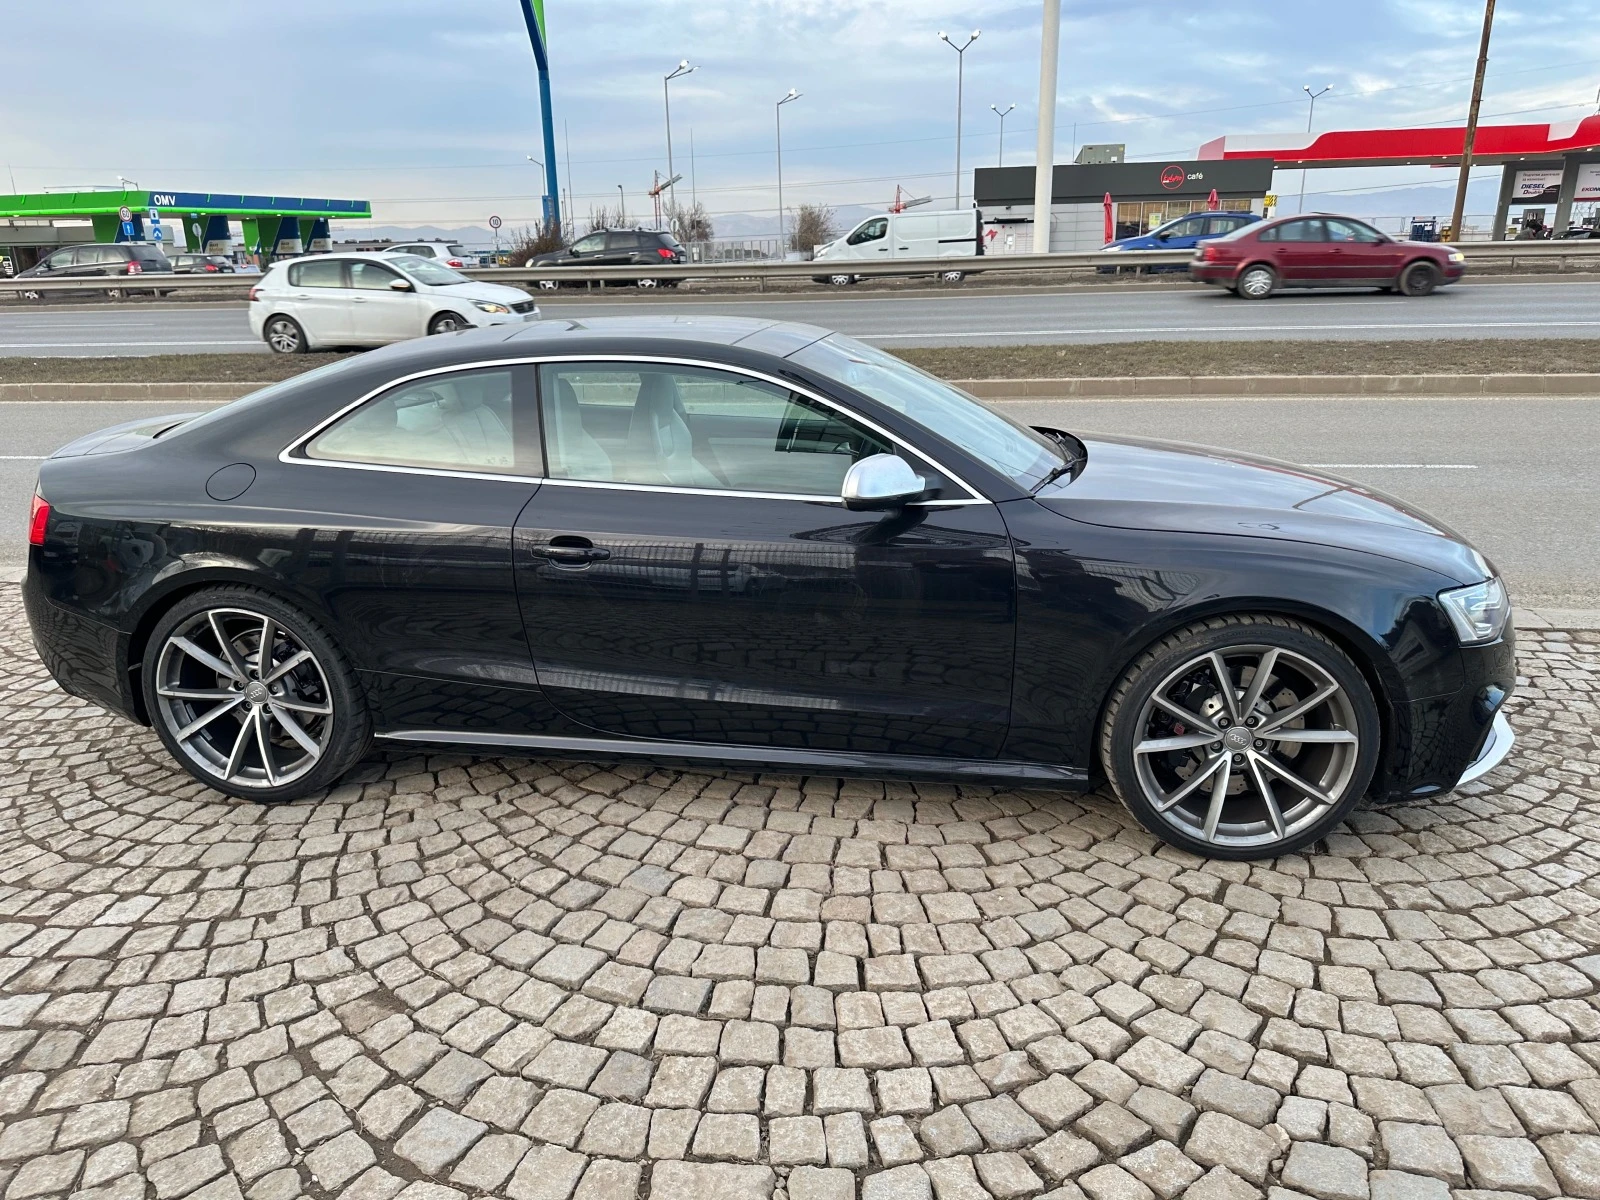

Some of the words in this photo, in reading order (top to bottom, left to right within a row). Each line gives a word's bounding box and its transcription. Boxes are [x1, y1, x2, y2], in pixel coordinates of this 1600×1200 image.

[1187, 172, 1203, 180] café
[153, 194, 176, 206] OMV
[121, 209, 129, 219] 60
